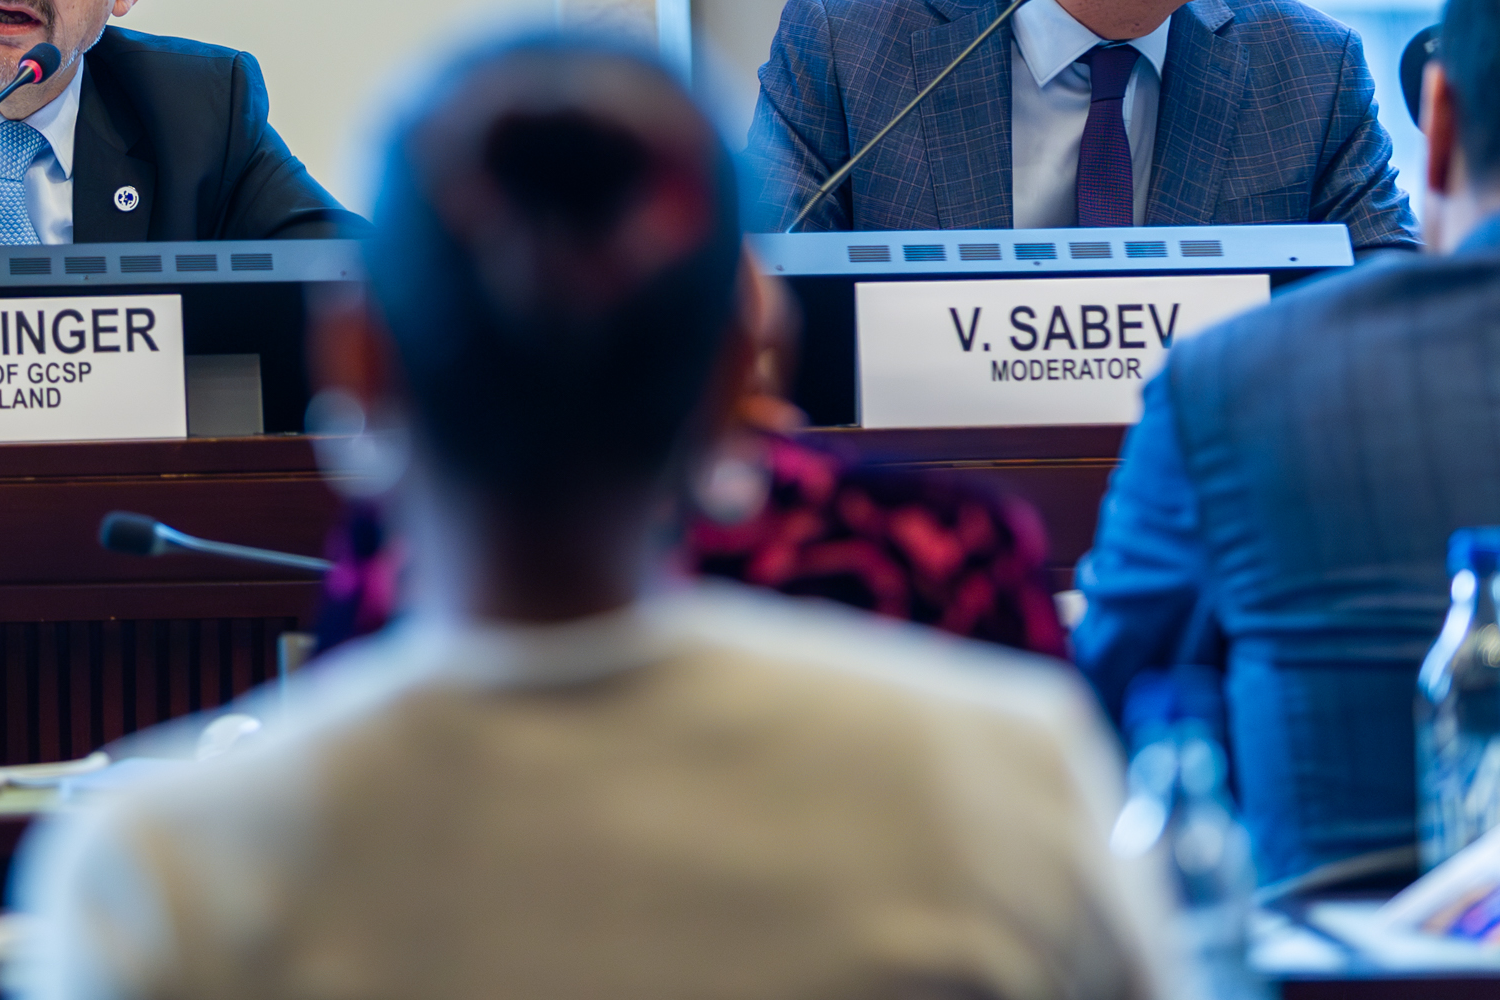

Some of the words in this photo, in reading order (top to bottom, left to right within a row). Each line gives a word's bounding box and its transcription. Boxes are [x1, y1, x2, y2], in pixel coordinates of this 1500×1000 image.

[949, 307, 991, 352] V.
[1009, 302, 1181, 352] SABEV
[27, 361, 93, 384] GCSP
[991, 357, 1143, 382] MODERATOR
